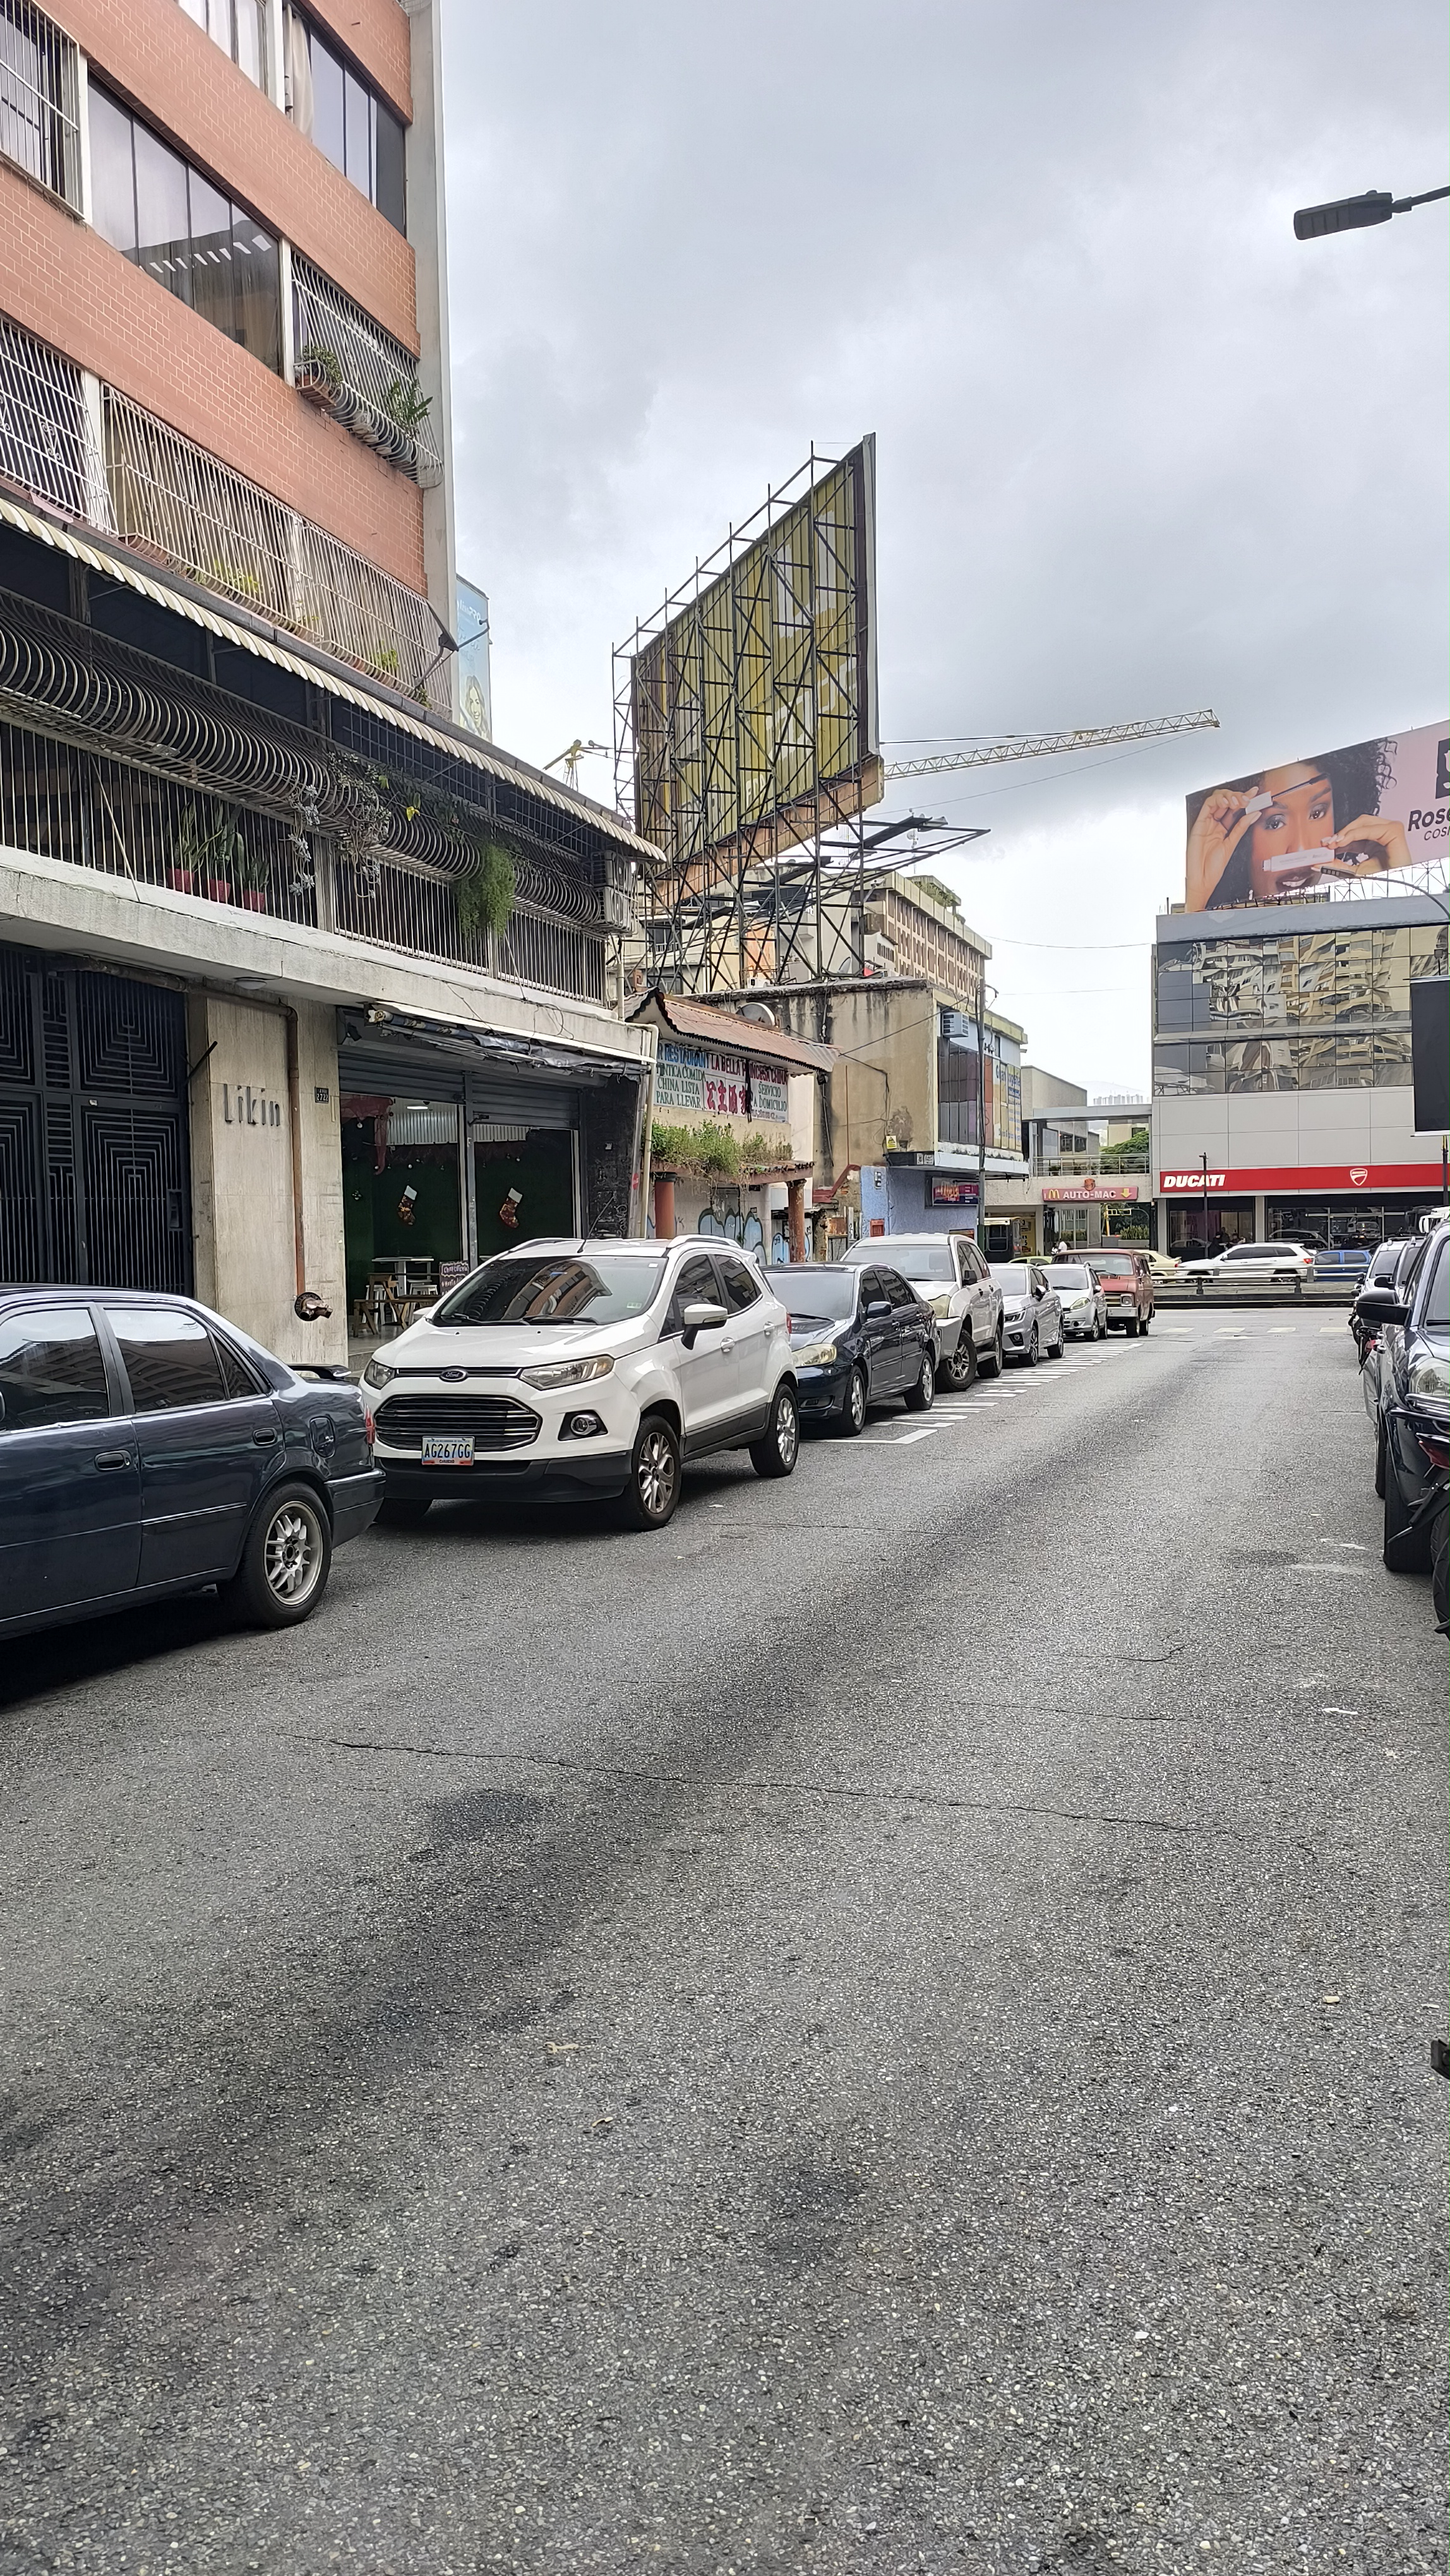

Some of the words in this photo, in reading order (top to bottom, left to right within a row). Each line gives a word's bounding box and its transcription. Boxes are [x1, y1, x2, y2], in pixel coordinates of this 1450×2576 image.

[711, 1054, 720, 1071] LA
[721, 1056, 741, 1076] BELLA
[657, 1077, 680, 1092] CHINA
[681, 1080, 700, 1095] LISTA
[758, 1082, 781, 1098] SERVICIO
[656, 1091, 674, 1106] PARA
[677, 1094, 702, 1109] LLEVAR
[753, 1096, 758, 1107] A
[759, 1095, 787, 1112] DOMICILIO
[1163, 1174, 1225, 1188] DUCATI
[1063, 1190, 1116, 1199] AUTO-MAC
[424, 1443, 470, 1458] AG267GG
